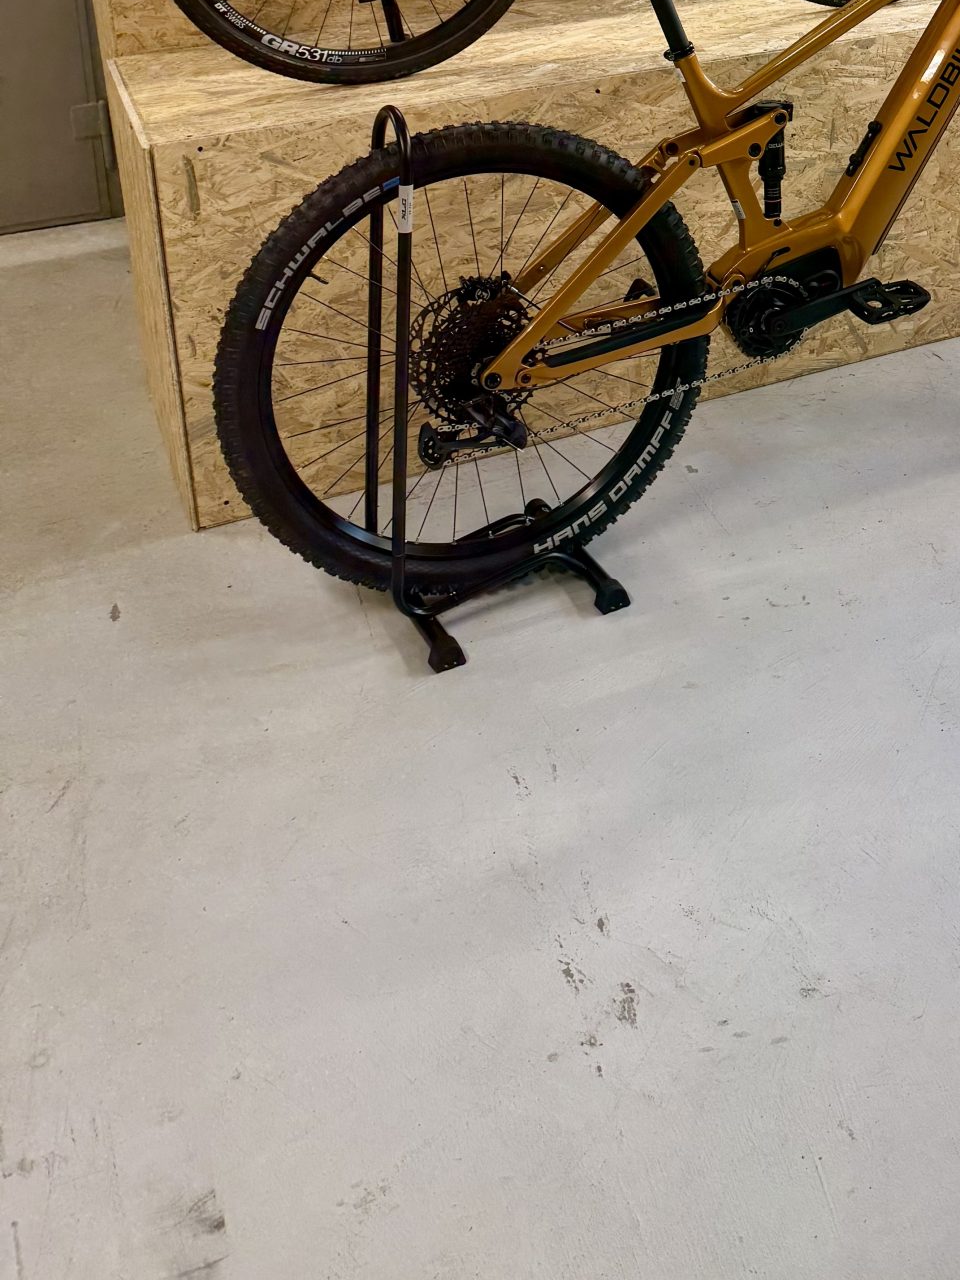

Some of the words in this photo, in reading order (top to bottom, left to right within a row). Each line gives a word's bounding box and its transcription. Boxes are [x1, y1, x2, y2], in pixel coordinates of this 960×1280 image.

[225, 11, 247, 30] SWISS
[254, 185, 382, 331] SCHWALBE
[533, 500, 608, 554] HANS
[608, 410, 673, 503] DAMPF
